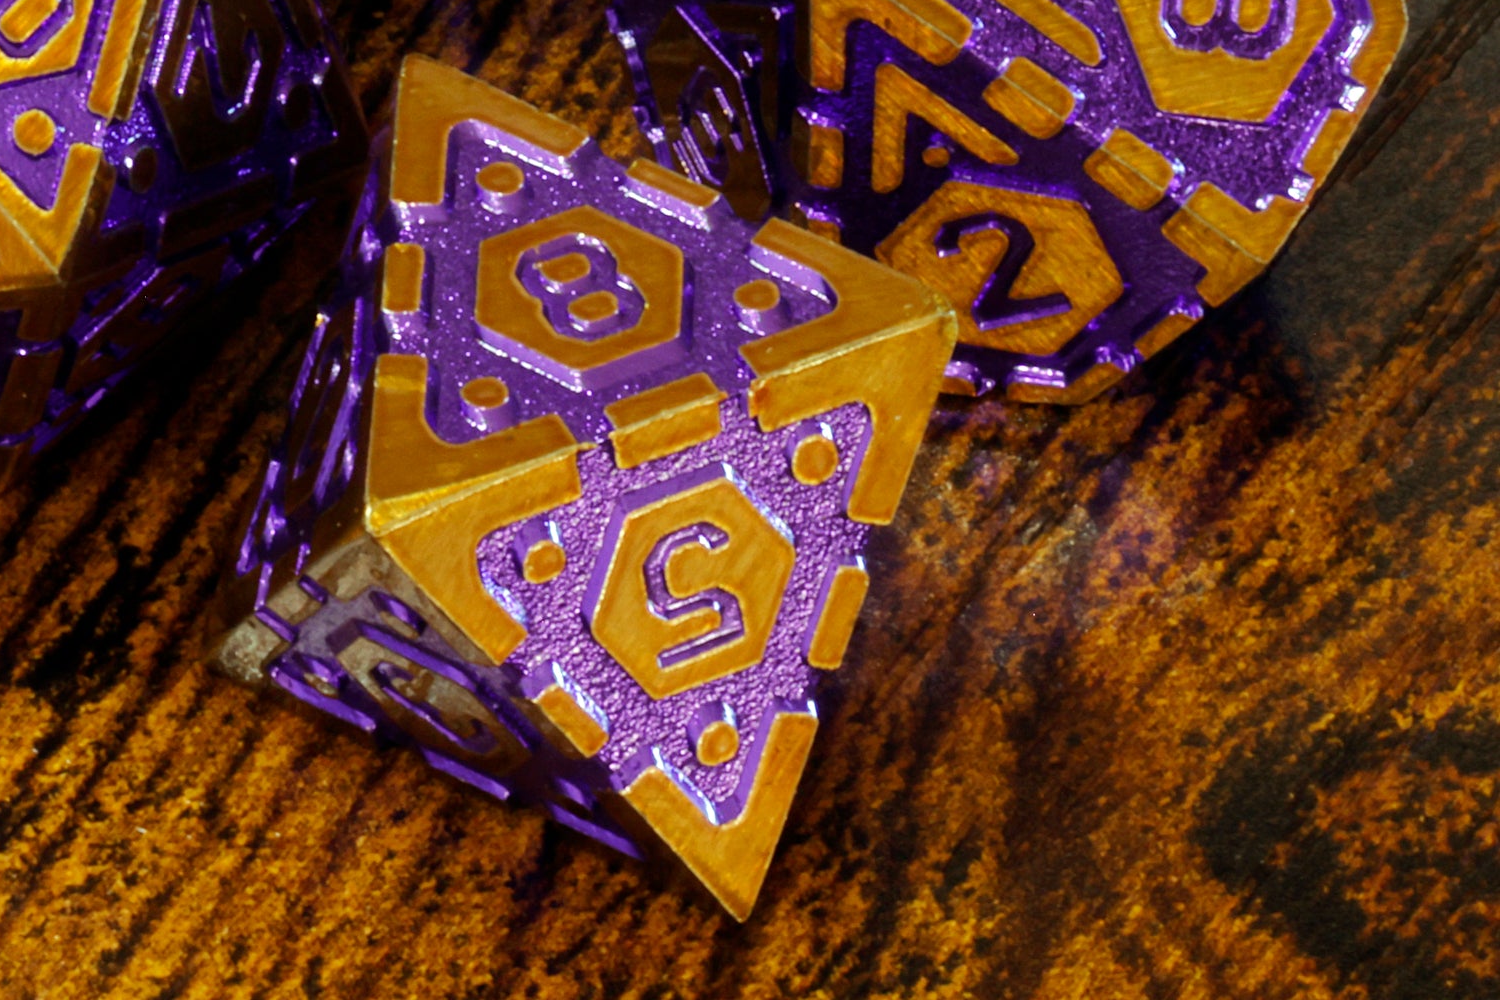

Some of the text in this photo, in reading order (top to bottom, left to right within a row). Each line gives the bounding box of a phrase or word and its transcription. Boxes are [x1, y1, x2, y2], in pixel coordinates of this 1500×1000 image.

[509, 231, 649, 344] 8
[933, 212, 1074, 333] 2
[641, 519, 746, 670] 5
